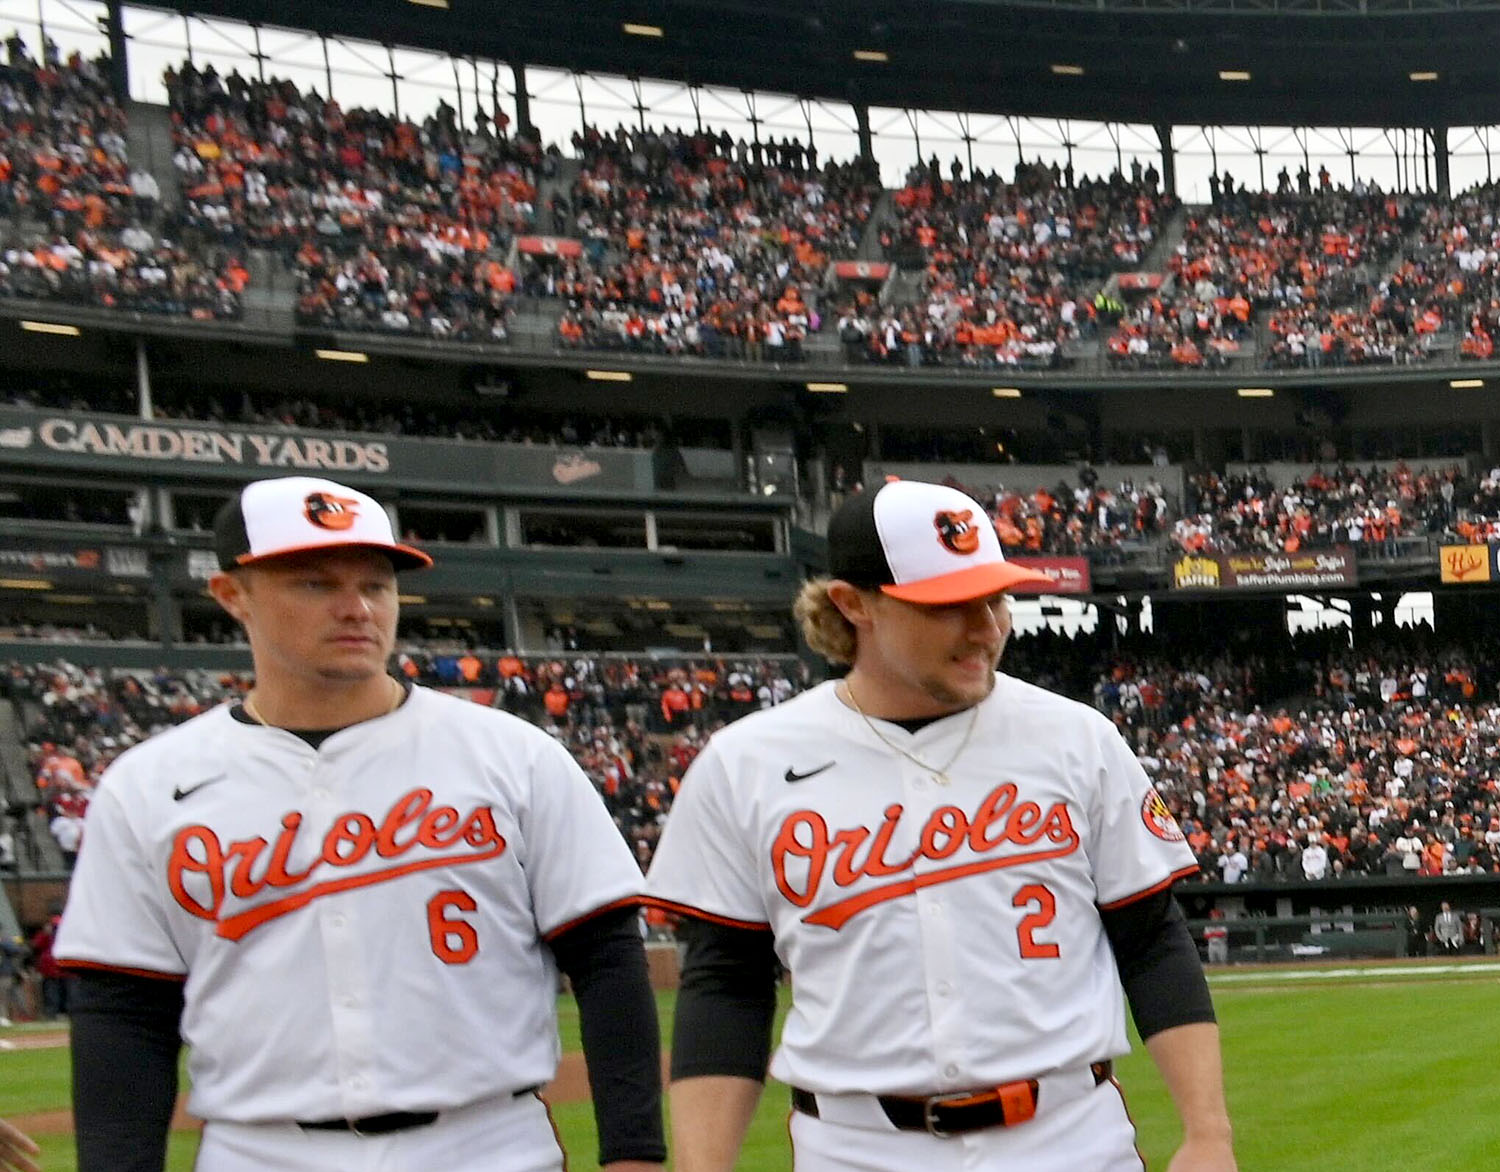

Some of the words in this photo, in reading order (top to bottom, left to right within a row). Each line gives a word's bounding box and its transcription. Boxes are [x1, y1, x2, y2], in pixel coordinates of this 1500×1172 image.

[39, 418, 243, 463] CAMDEN
[247, 434, 390, 473] YARDS
[1236, 573, 1345, 587] SafferPlumbing.com
[167, 786, 505, 921] Orioles
[771, 782, 1079, 908] Orioles
[427, 889, 479, 965] 6
[1012, 883, 1061, 959] 2
